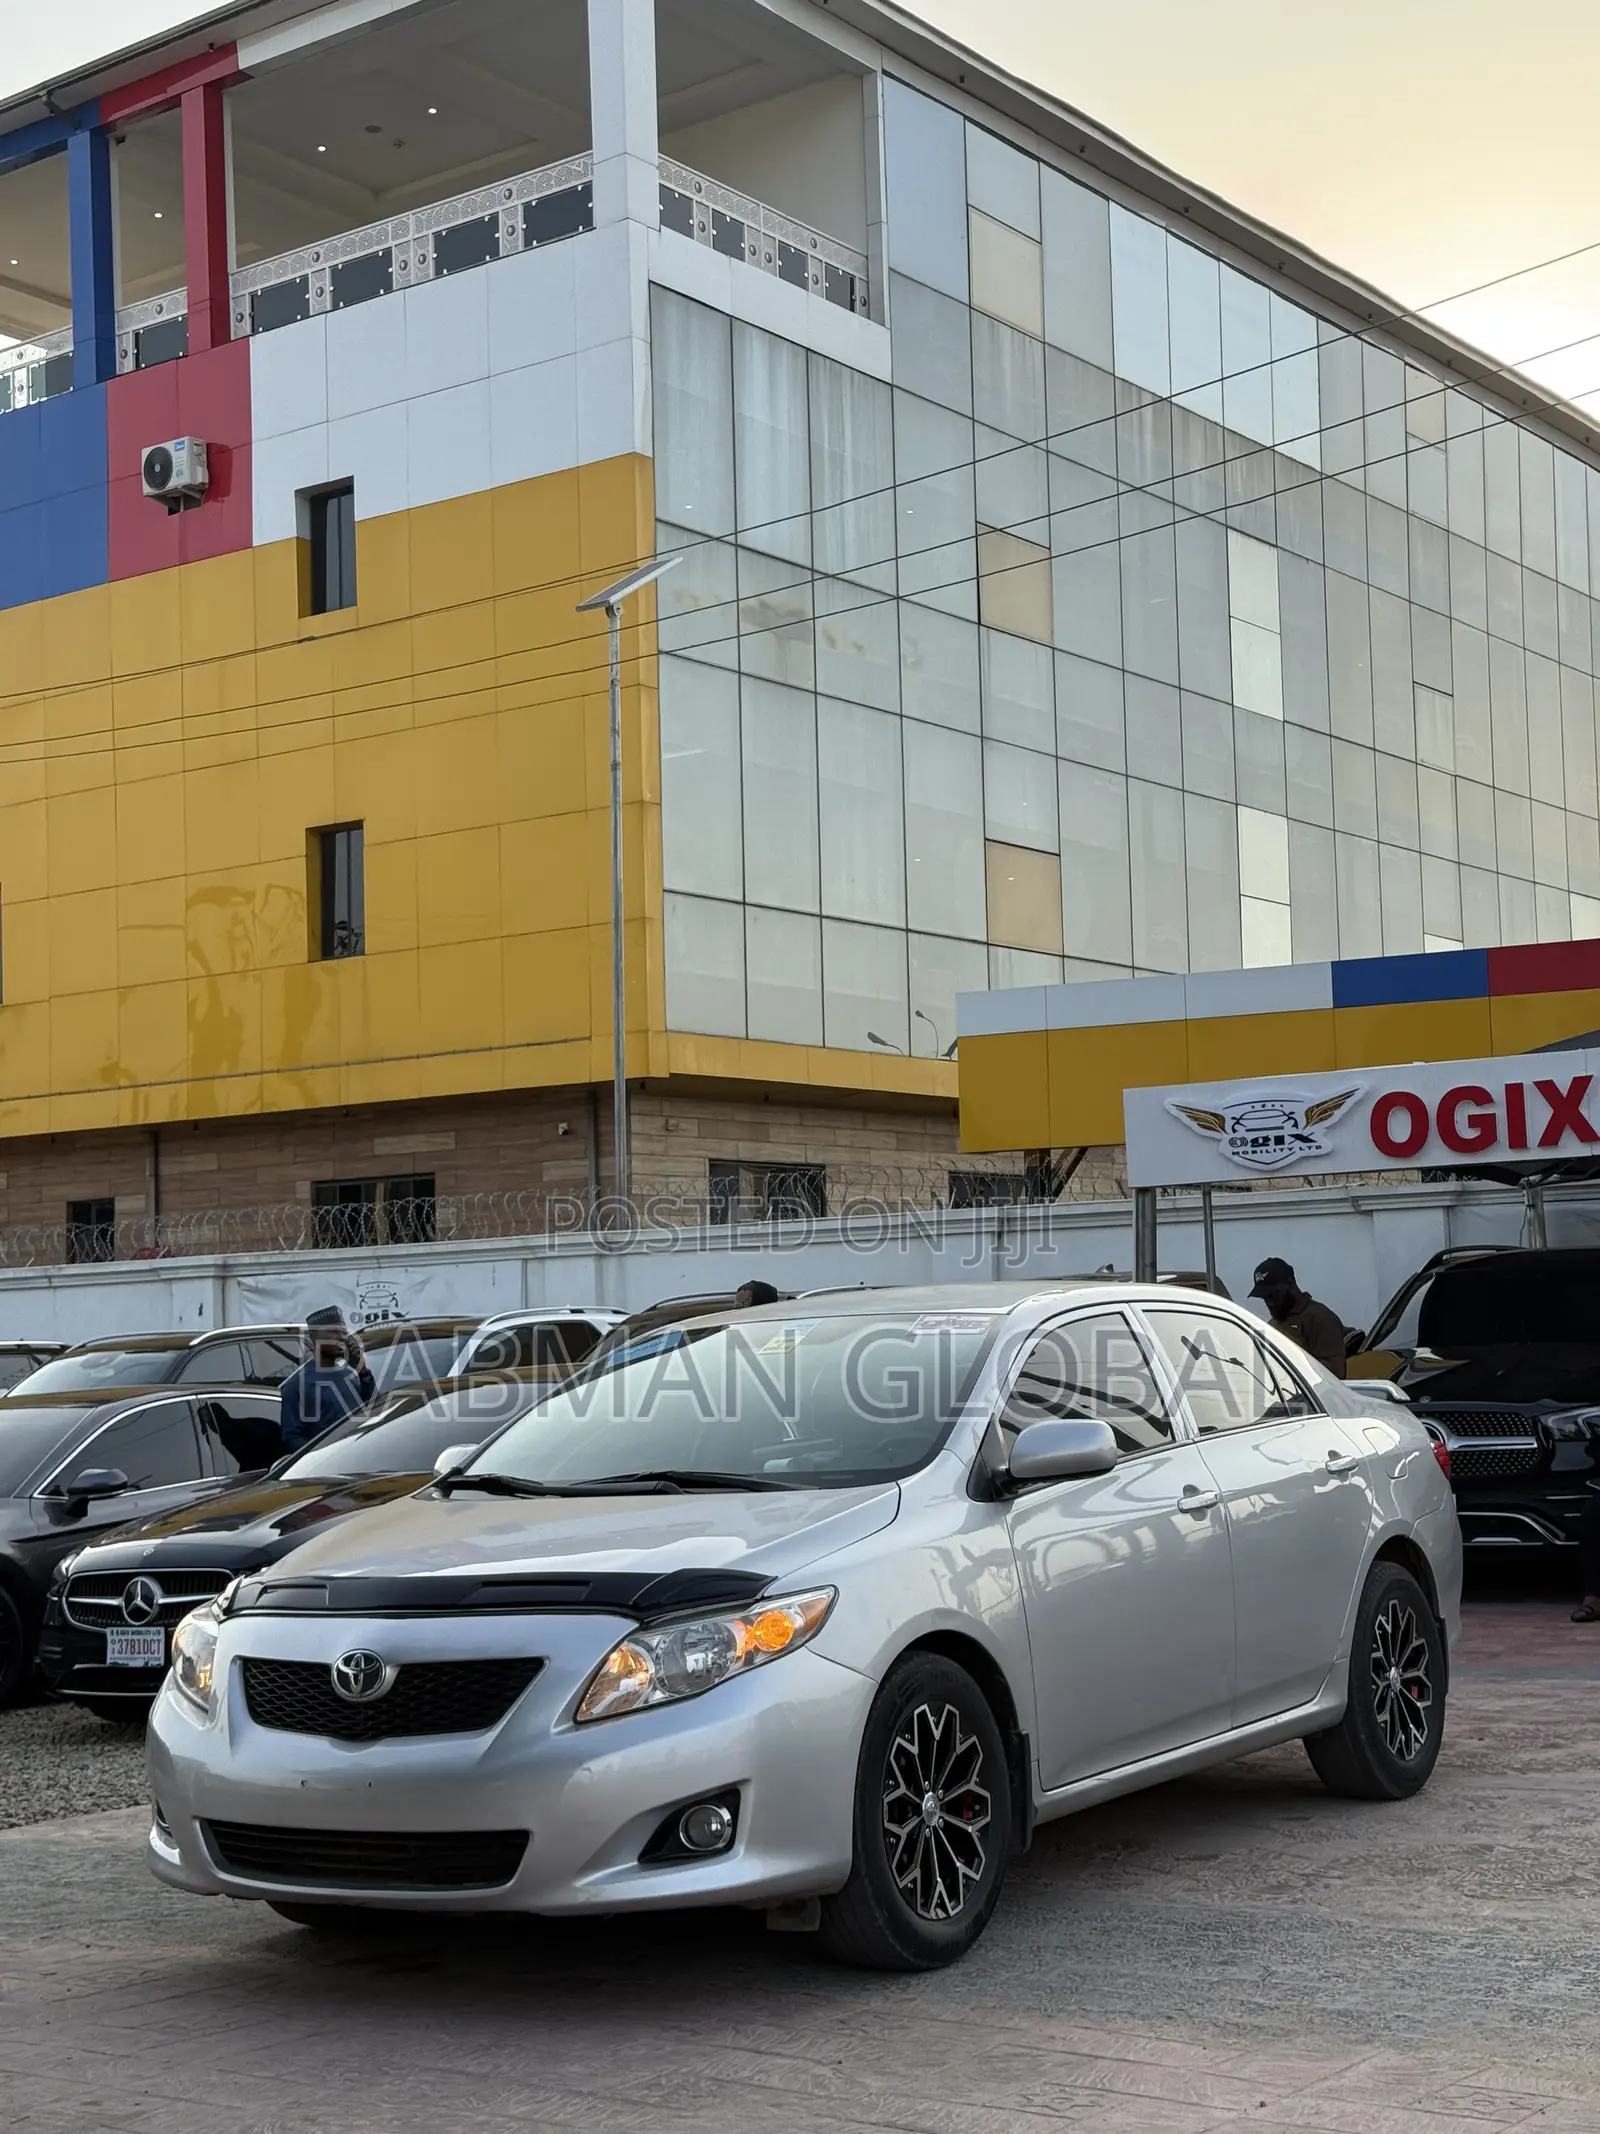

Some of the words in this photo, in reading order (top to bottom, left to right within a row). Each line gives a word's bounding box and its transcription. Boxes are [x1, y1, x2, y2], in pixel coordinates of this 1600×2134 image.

[1370, 1074, 1600, 1158] OGIX
[1231, 1146, 1294, 1156] MOBILITY
[1299, 1144, 1322, 1152] LTD
